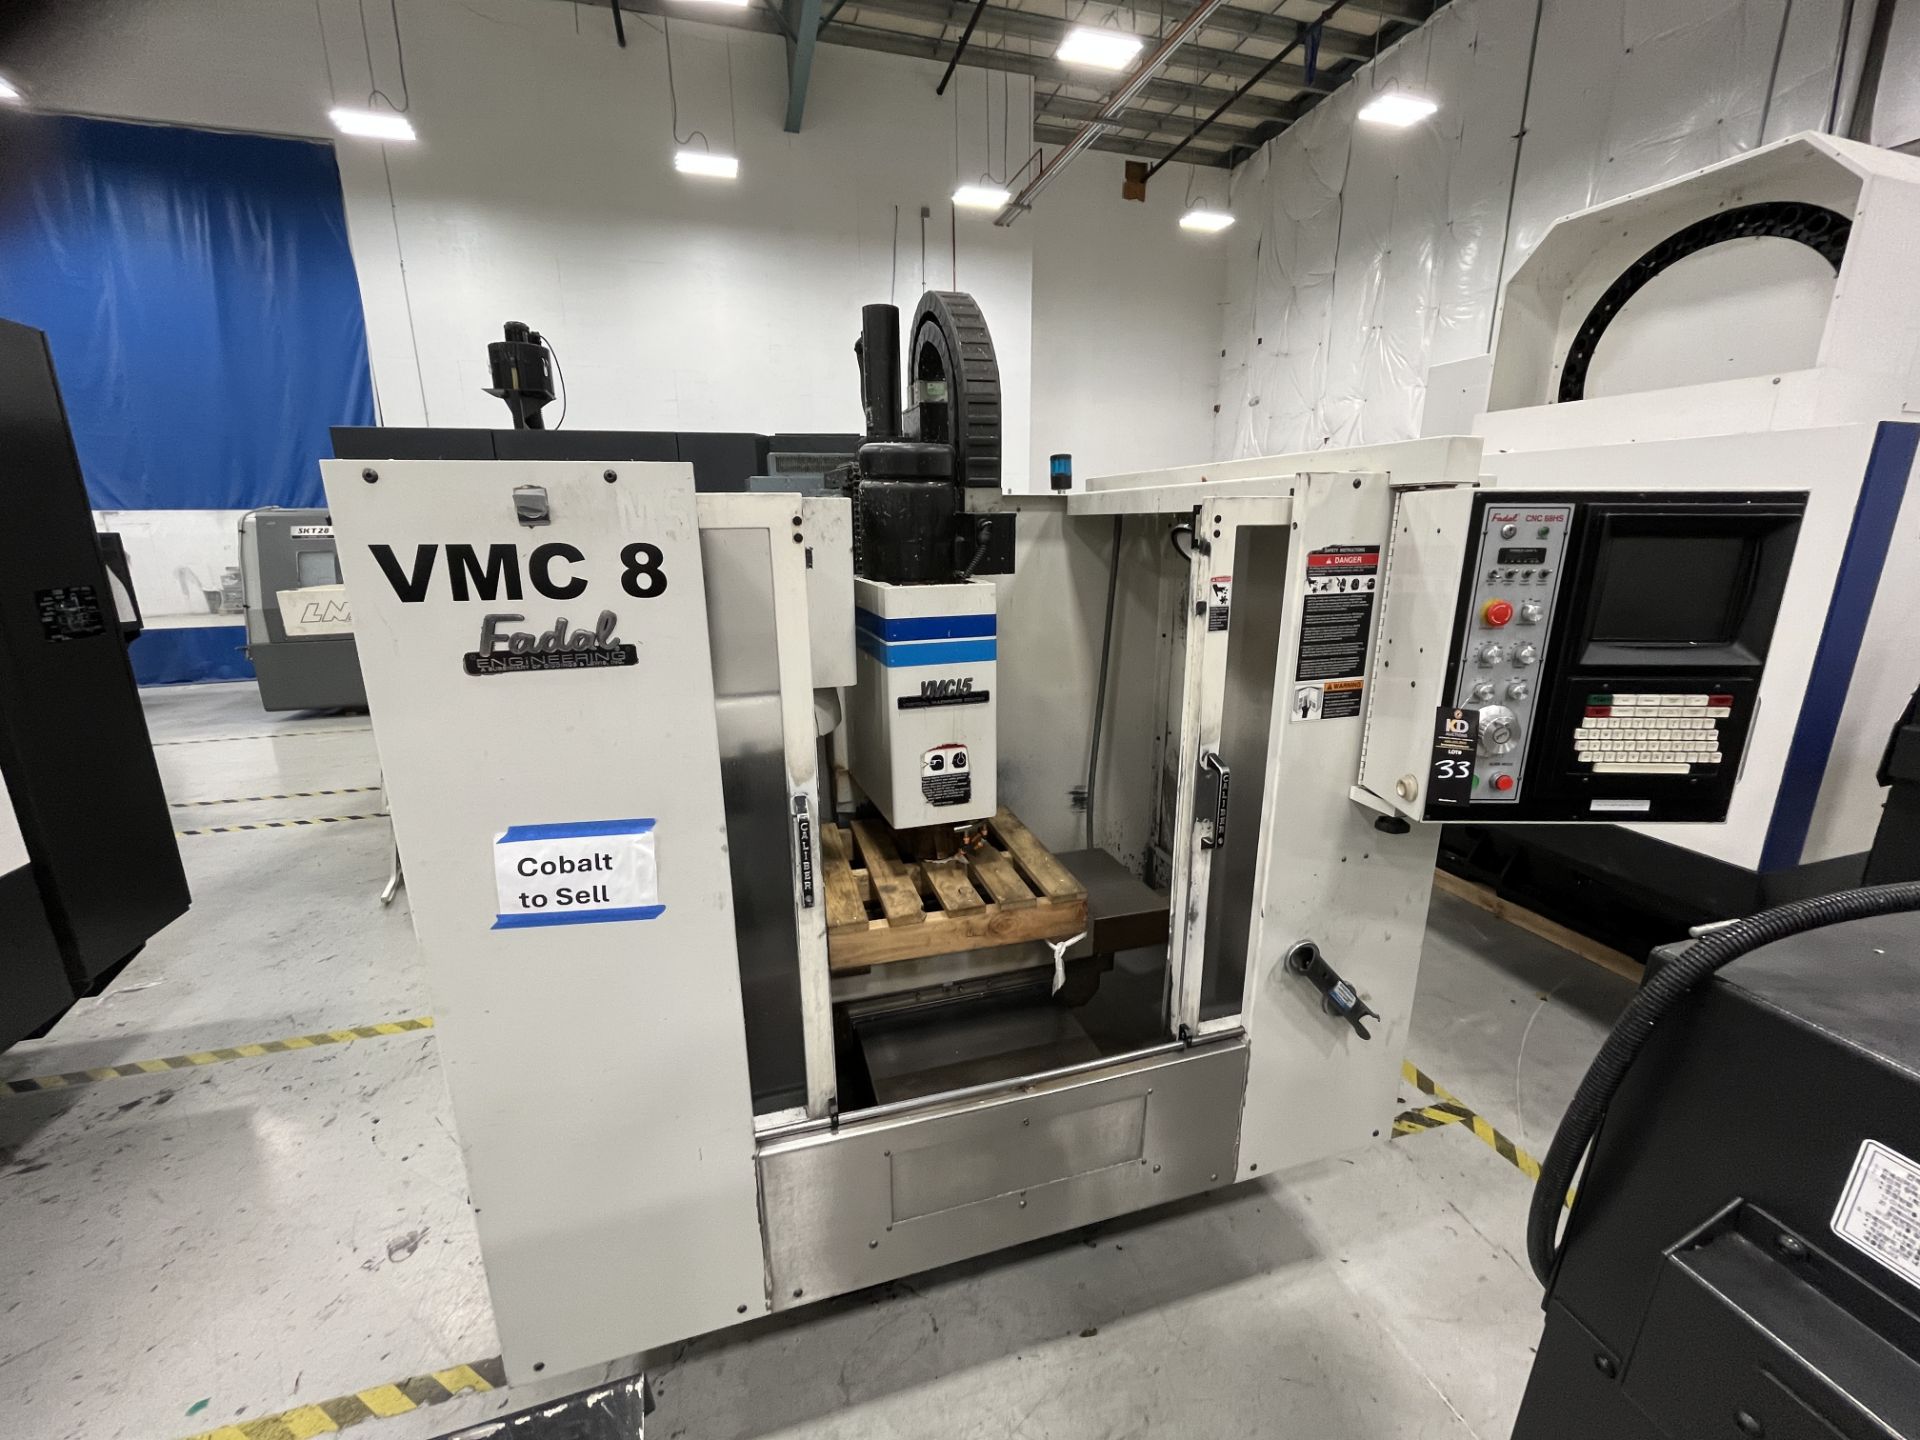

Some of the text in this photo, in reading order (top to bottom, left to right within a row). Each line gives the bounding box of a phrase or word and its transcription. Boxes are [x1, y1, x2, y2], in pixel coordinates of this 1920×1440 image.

[1334, 556, 1362, 564] DANGER
[367, 542, 667, 603] VMC 8
[480, 609, 620, 657] Fadal
[476, 651, 626, 669] ENGINEERING
[1333, 681, 1361, 689] WARNING
[1435, 759, 1471, 779] 33
[517, 853, 613, 877] Cobalt
[800, 822, 812, 890] CALIBER
[518, 885, 610, 908] to Sell
